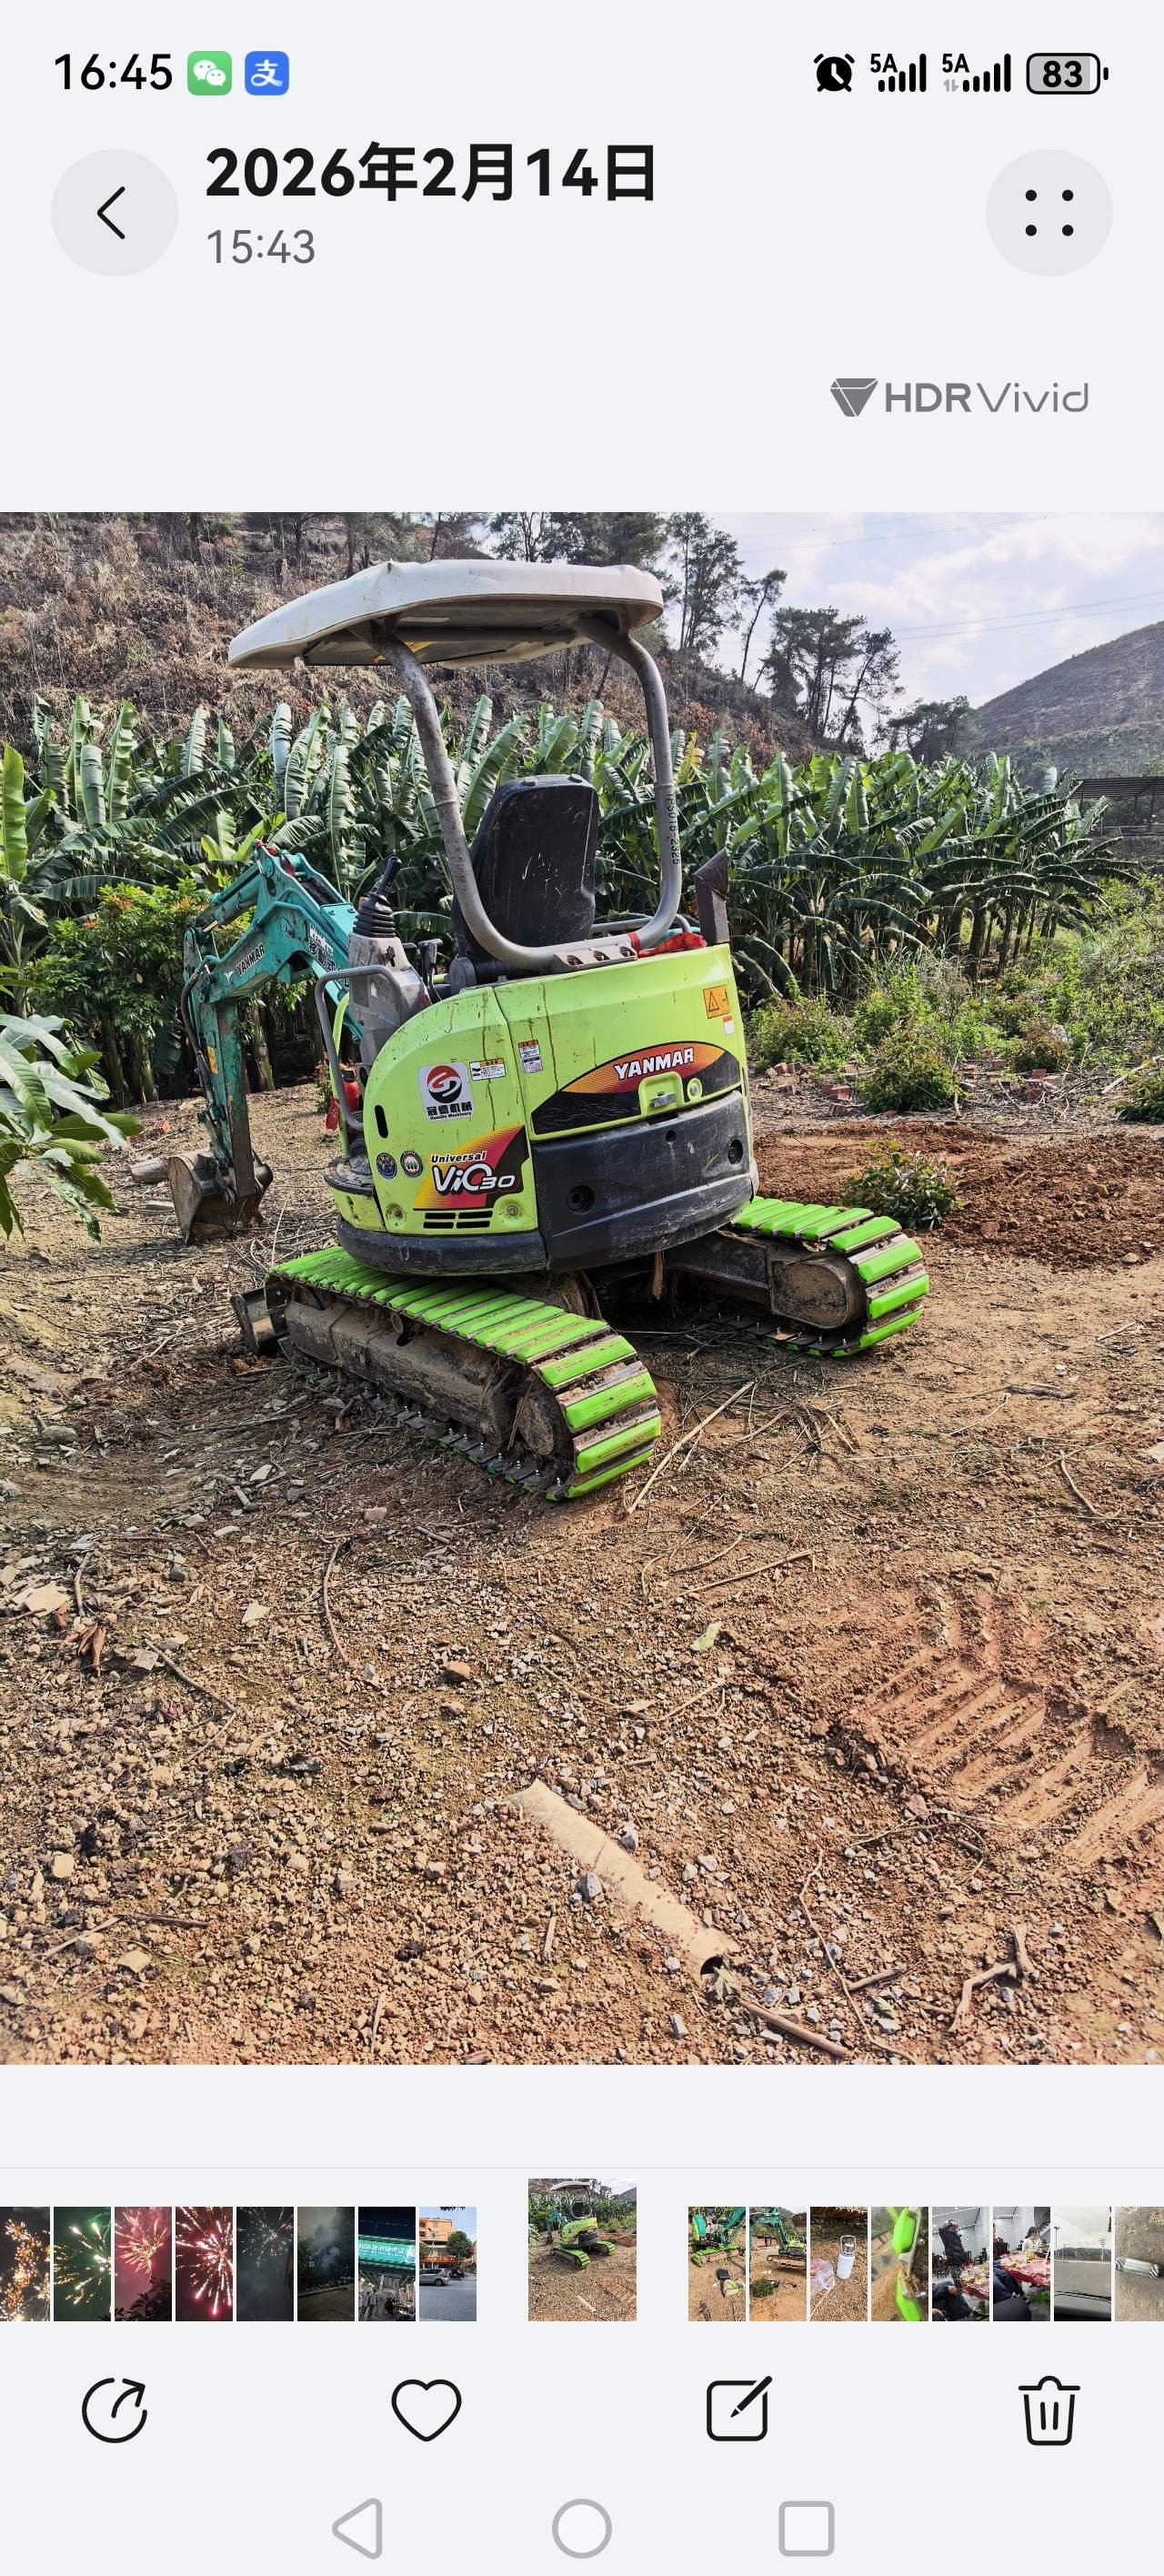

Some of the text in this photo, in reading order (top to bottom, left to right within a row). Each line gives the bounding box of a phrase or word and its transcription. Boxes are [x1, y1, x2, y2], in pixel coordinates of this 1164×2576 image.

[55, 53, 173, 91] 16:45
[869, 53, 898, 74] 5A
[941, 53, 970, 74] 5A
[1042, 60, 1083, 88] 83
[206, 140, 655, 203] 2026年2月14日
[207, 229, 316, 265] 15:43
[885, 382, 1089, 413] HDR Vivid
[236, 942, 266, 976] YANMAR
[614, 1047, 694, 1080] YANMAR
[431, 1151, 487, 1163] Universal
